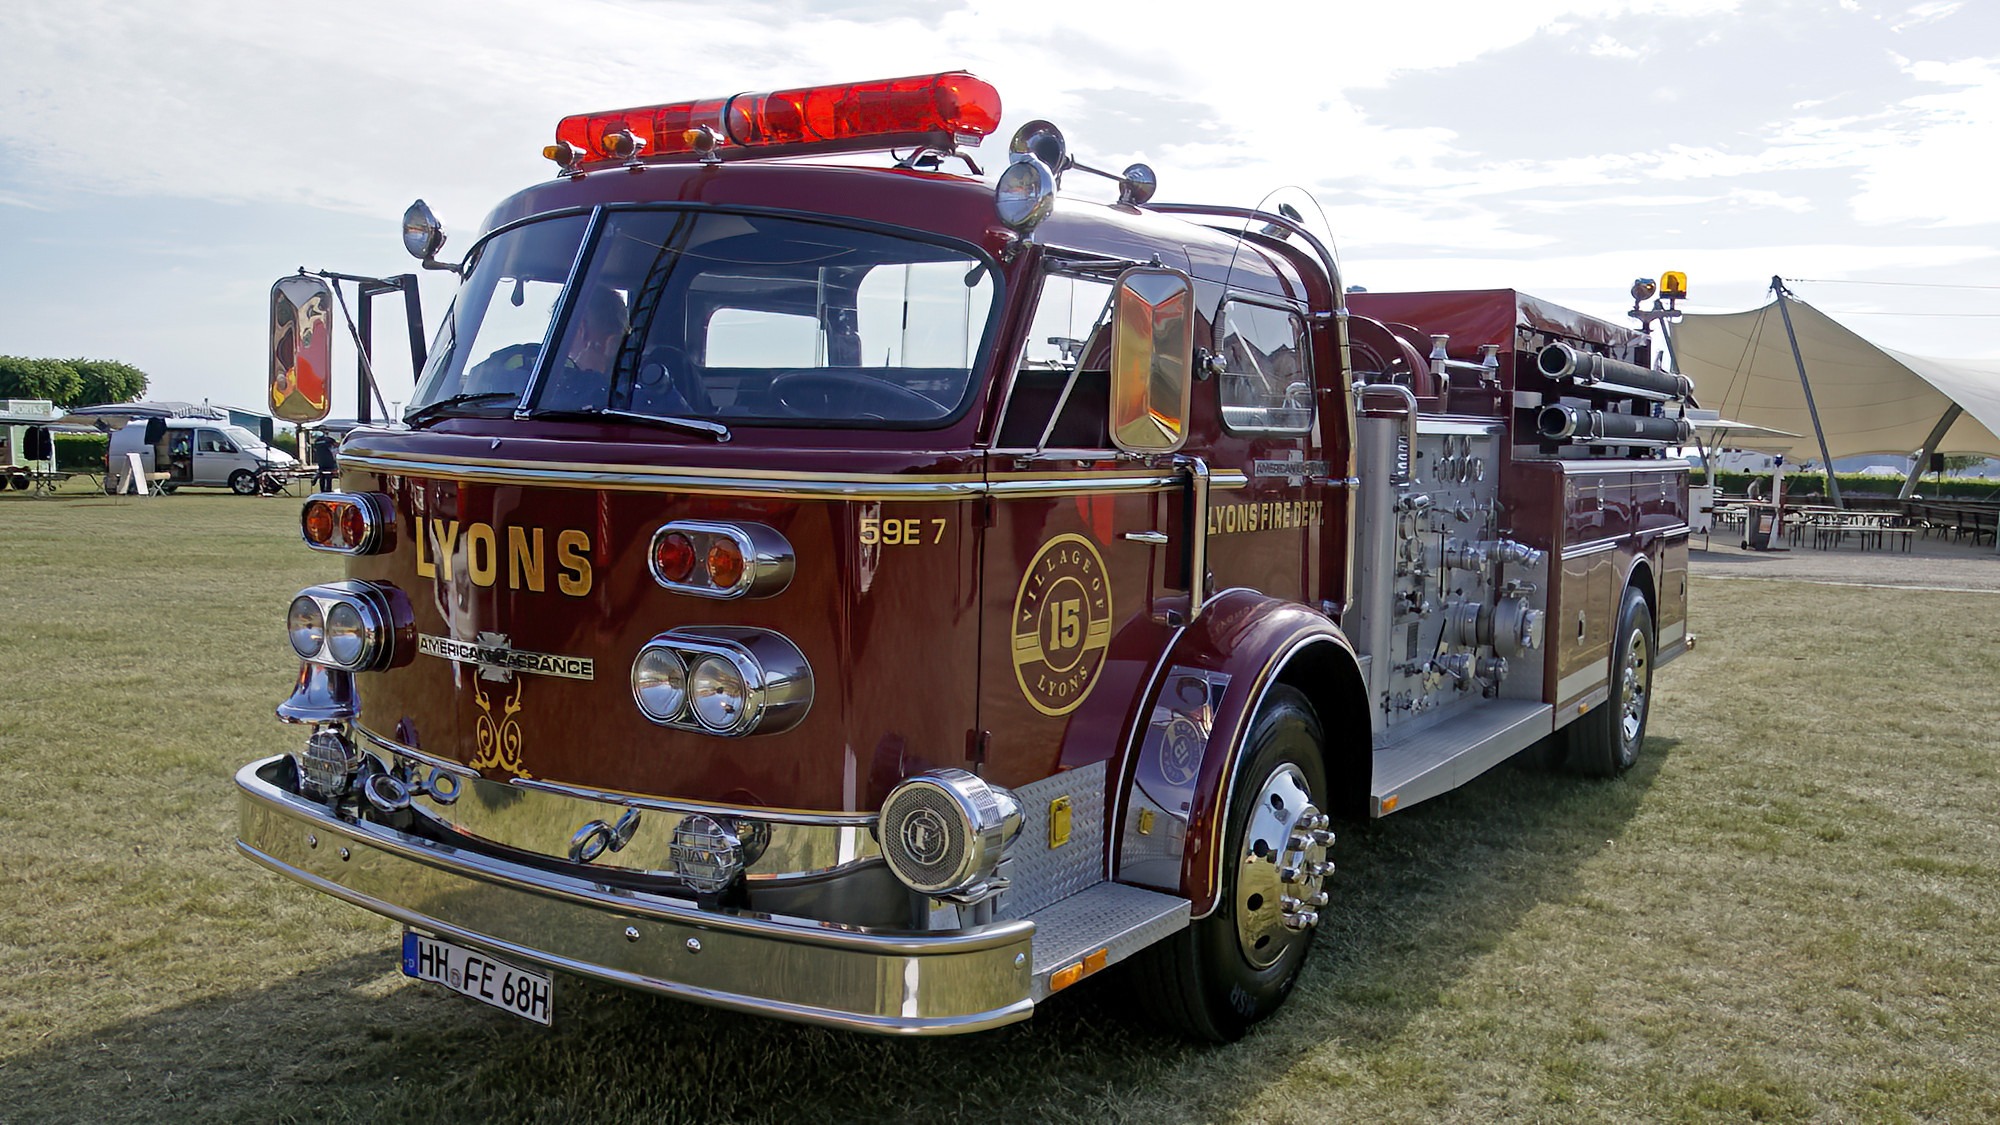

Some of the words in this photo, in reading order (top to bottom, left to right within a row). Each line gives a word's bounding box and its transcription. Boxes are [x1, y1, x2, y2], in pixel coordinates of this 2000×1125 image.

[860, 519, 920, 545] 59E
[931, 518, 946, 545] 7
[1207, 503, 1258, 535] LYONS
[1261, 502, 1291, 530] FIRE
[415, 516, 593, 598] LYONS
[1022, 550, 1092, 623] VILLAGE
[1050, 598, 1081, 651] 15
[420, 637, 491, 663] AMERICAN
[1037, 665, 1089, 697] LYONS
[408, 958, 415, 968] D
[419, 941, 449, 982] HH
[463, 957, 497, 1000] FE
[502, 971, 548, 1020] 68H
